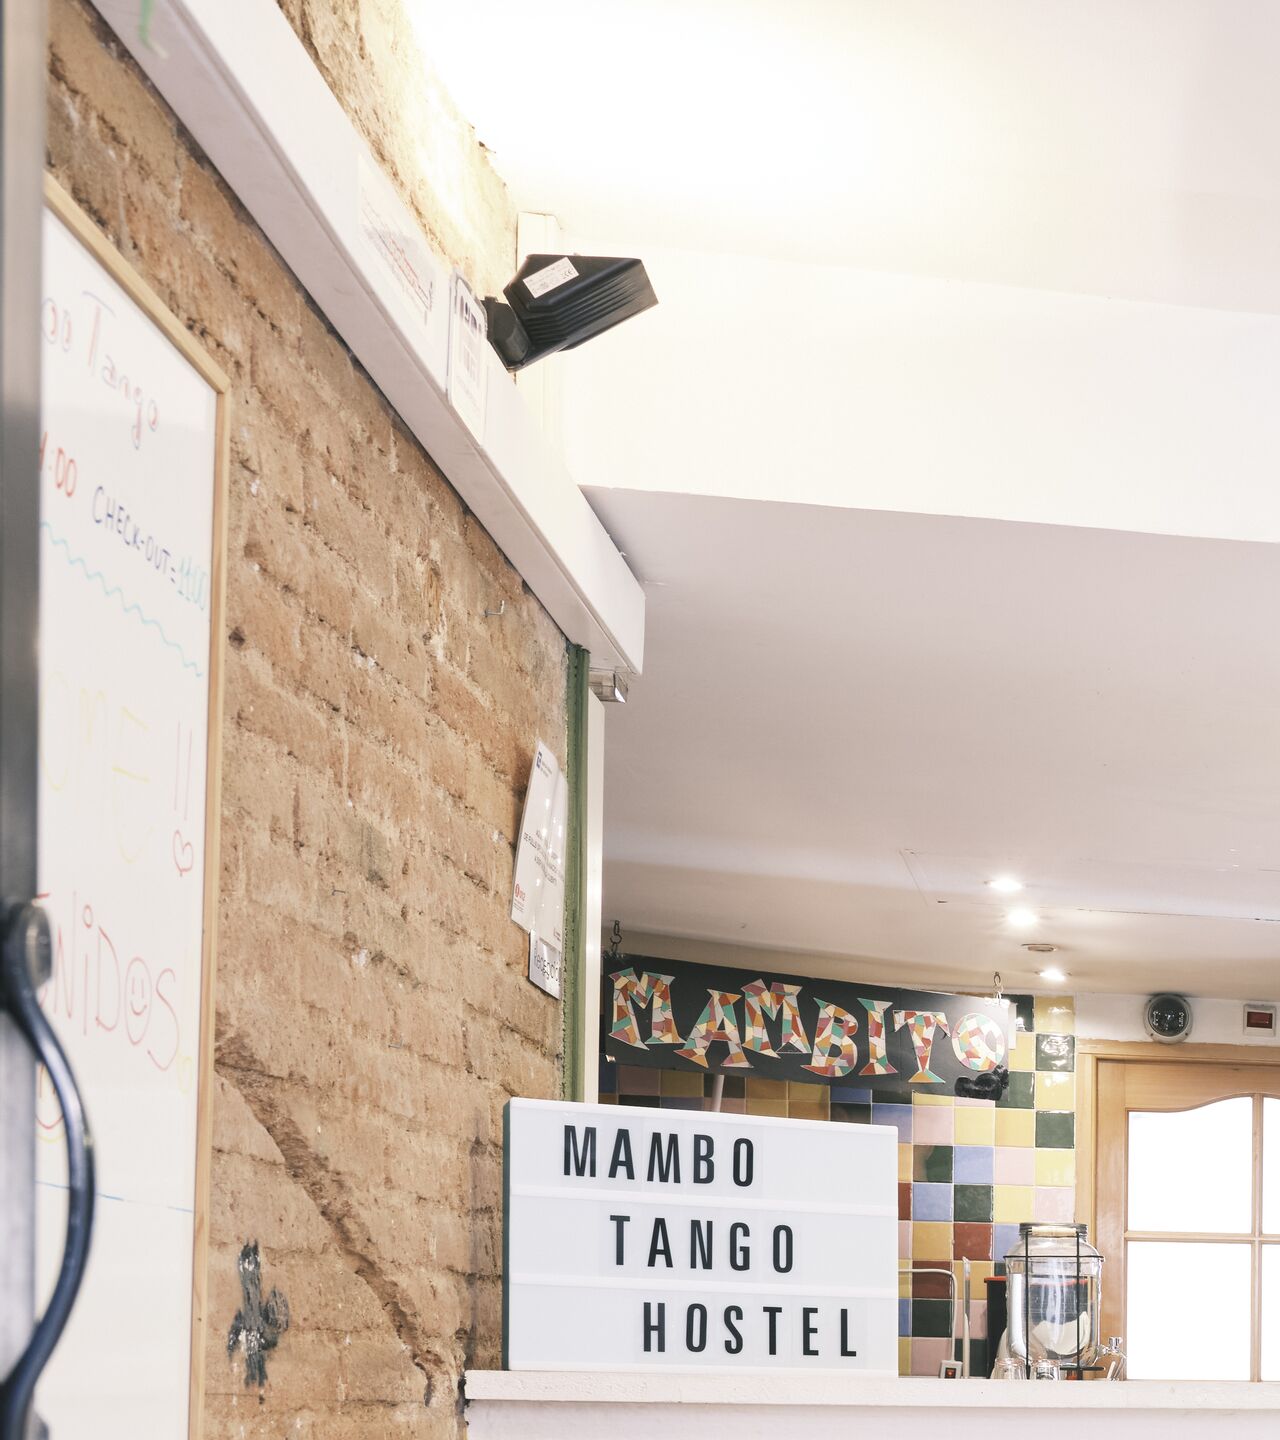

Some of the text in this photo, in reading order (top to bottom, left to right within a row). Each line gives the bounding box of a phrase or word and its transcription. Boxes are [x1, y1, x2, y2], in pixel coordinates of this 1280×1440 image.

[608, 966, 1007, 1084] MAMBITO
[563, 1124, 755, 1188] MAMBO
[609, 1214, 794, 1274] TANGO
[643, 1301, 858, 1357] HOSTEL
